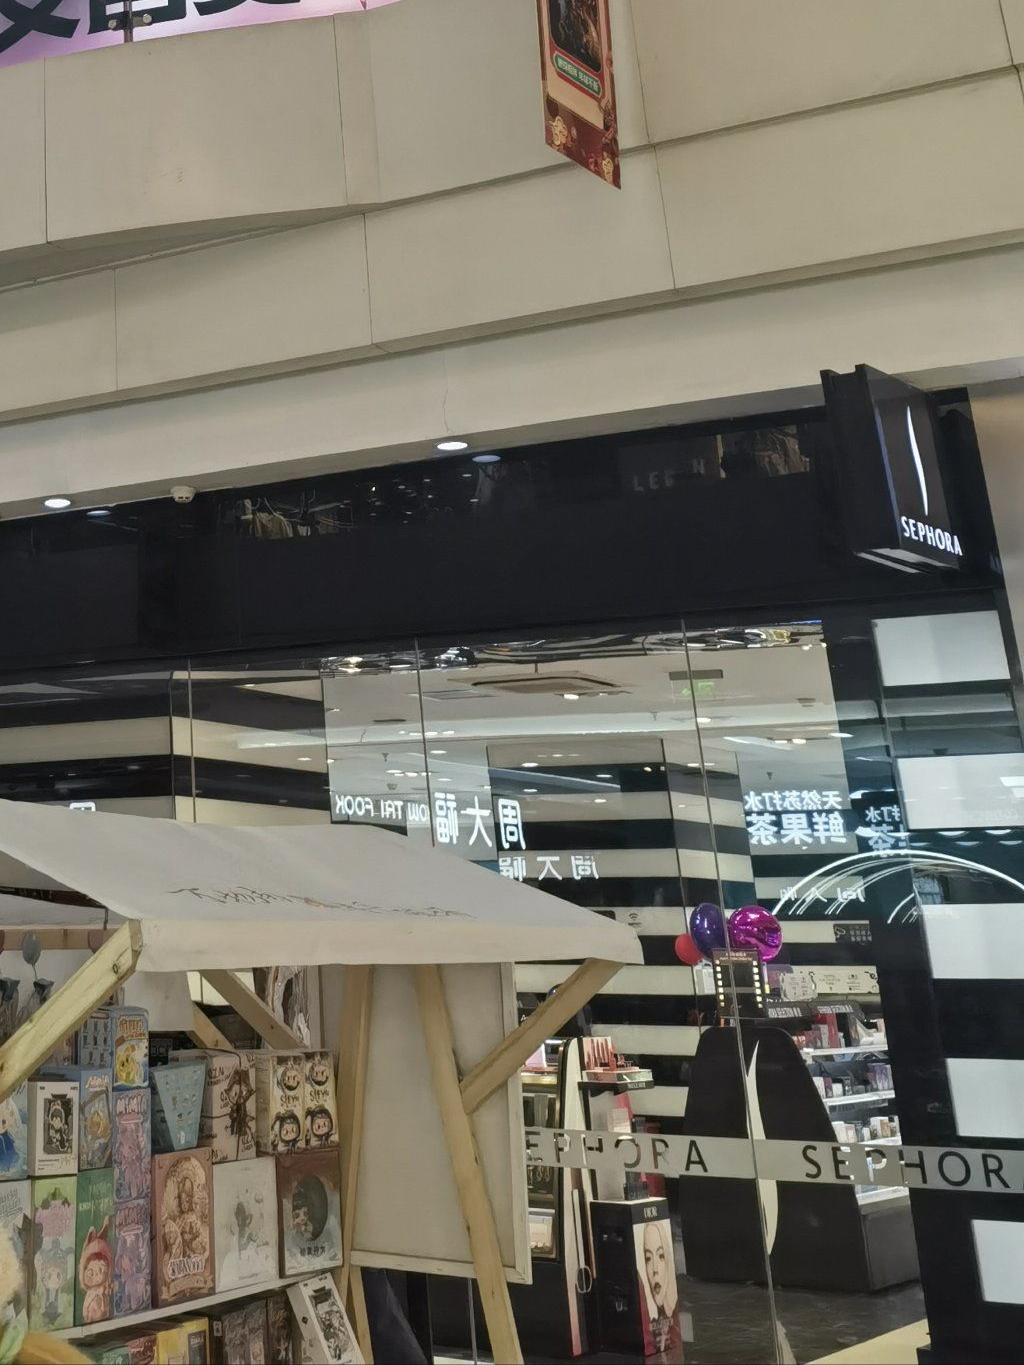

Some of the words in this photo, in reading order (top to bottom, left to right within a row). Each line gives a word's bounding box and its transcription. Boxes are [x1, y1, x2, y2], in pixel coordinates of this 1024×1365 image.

[900, 515, 963, 556] SEPHORA
[525, 1130, 708, 1173] EPHORA
[802, 1144, 1024, 1189] SEPHOR
